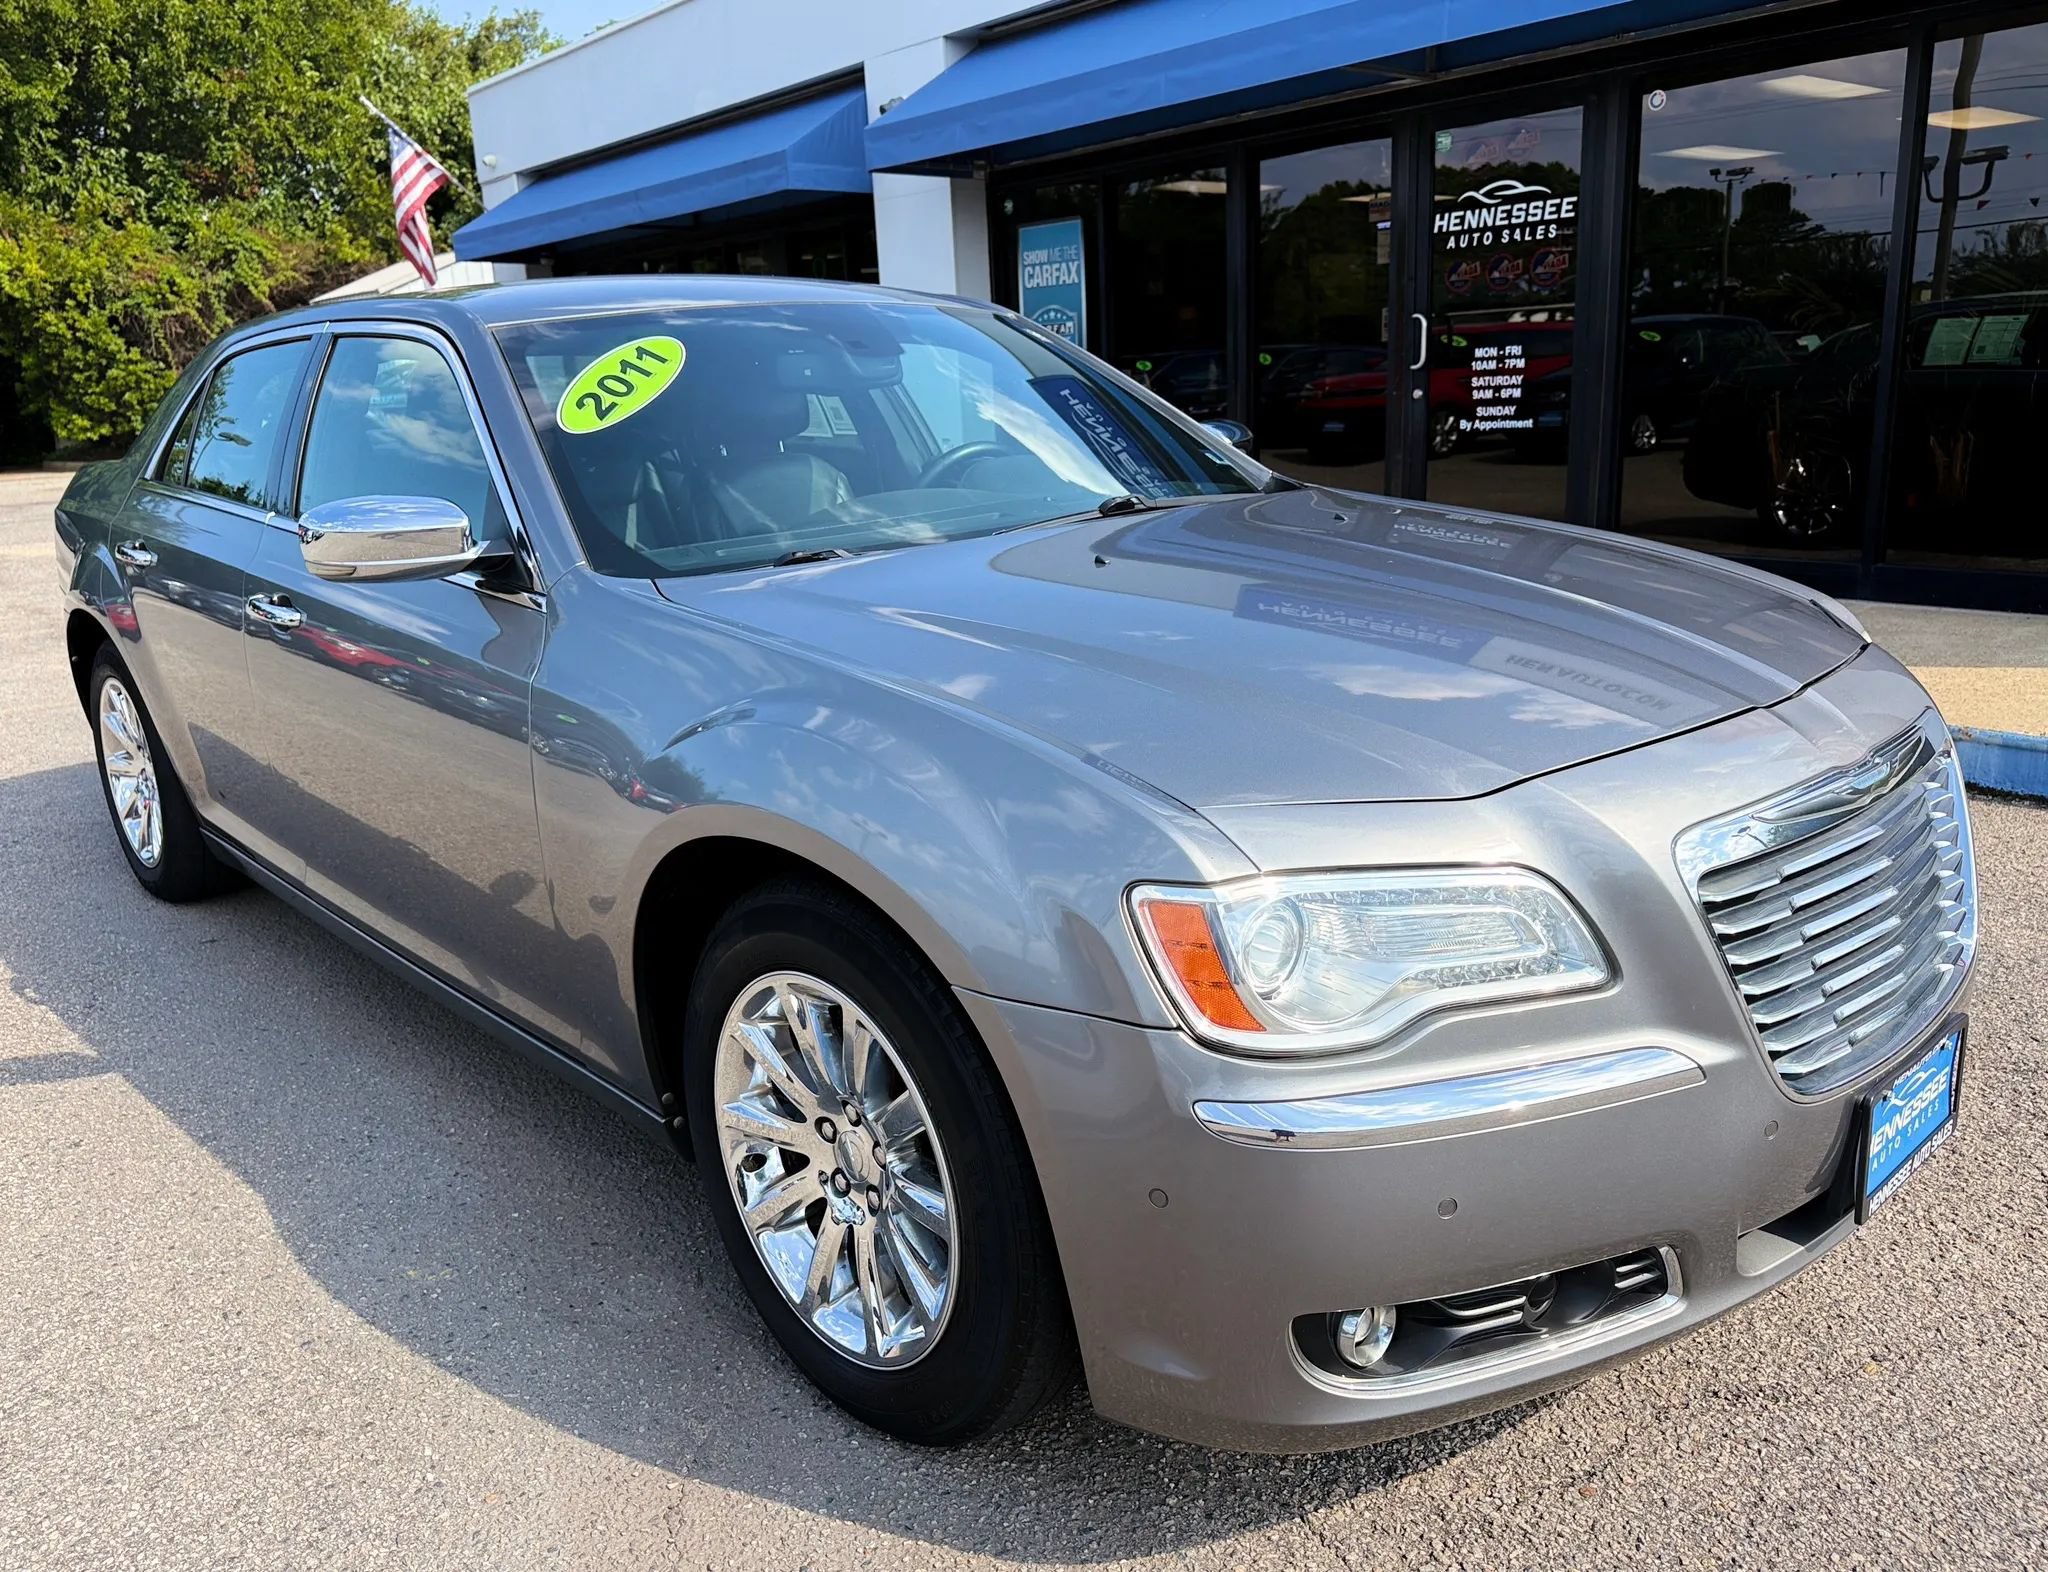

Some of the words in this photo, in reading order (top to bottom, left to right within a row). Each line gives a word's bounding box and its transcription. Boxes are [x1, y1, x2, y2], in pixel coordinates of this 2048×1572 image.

[1433, 196, 1578, 234] HENNESSEE
[1446, 231, 1493, 250] AUTO
[1501, 224, 1558, 243] SALES
[1023, 250, 1048, 265] SHOW
[1050, 247, 1061, 261] ME
[1063, 245, 1078, 260] THE
[1024, 261, 1080, 289] CARFAX
[1474, 347, 1498, 358] MON
[1505, 345, 1522, 356] FRI
[1471, 360, 1497, 371] 10AM
[1504, 358, 1525, 369] 7PM
[576, 346, 669, 421] 2011
[1471, 375, 1524, 387] SATURDAY
[1472, 389, 1493, 400] 9AM
[1500, 388, 1521, 399] 6PM
[1476, 405, 1517, 417] SUNDAY
[1459, 419, 1472, 431] By
[1473, 418, 1533, 431] Appointment
[1872, 1136, 1901, 1172] AUTO
[1907, 1098, 1940, 1137] SALES
[1868, 1158, 1913, 1217] HENNESSEE
[1911, 1140, 1932, 1173] AUTO
[1931, 1118, 1955, 1153] SALES
